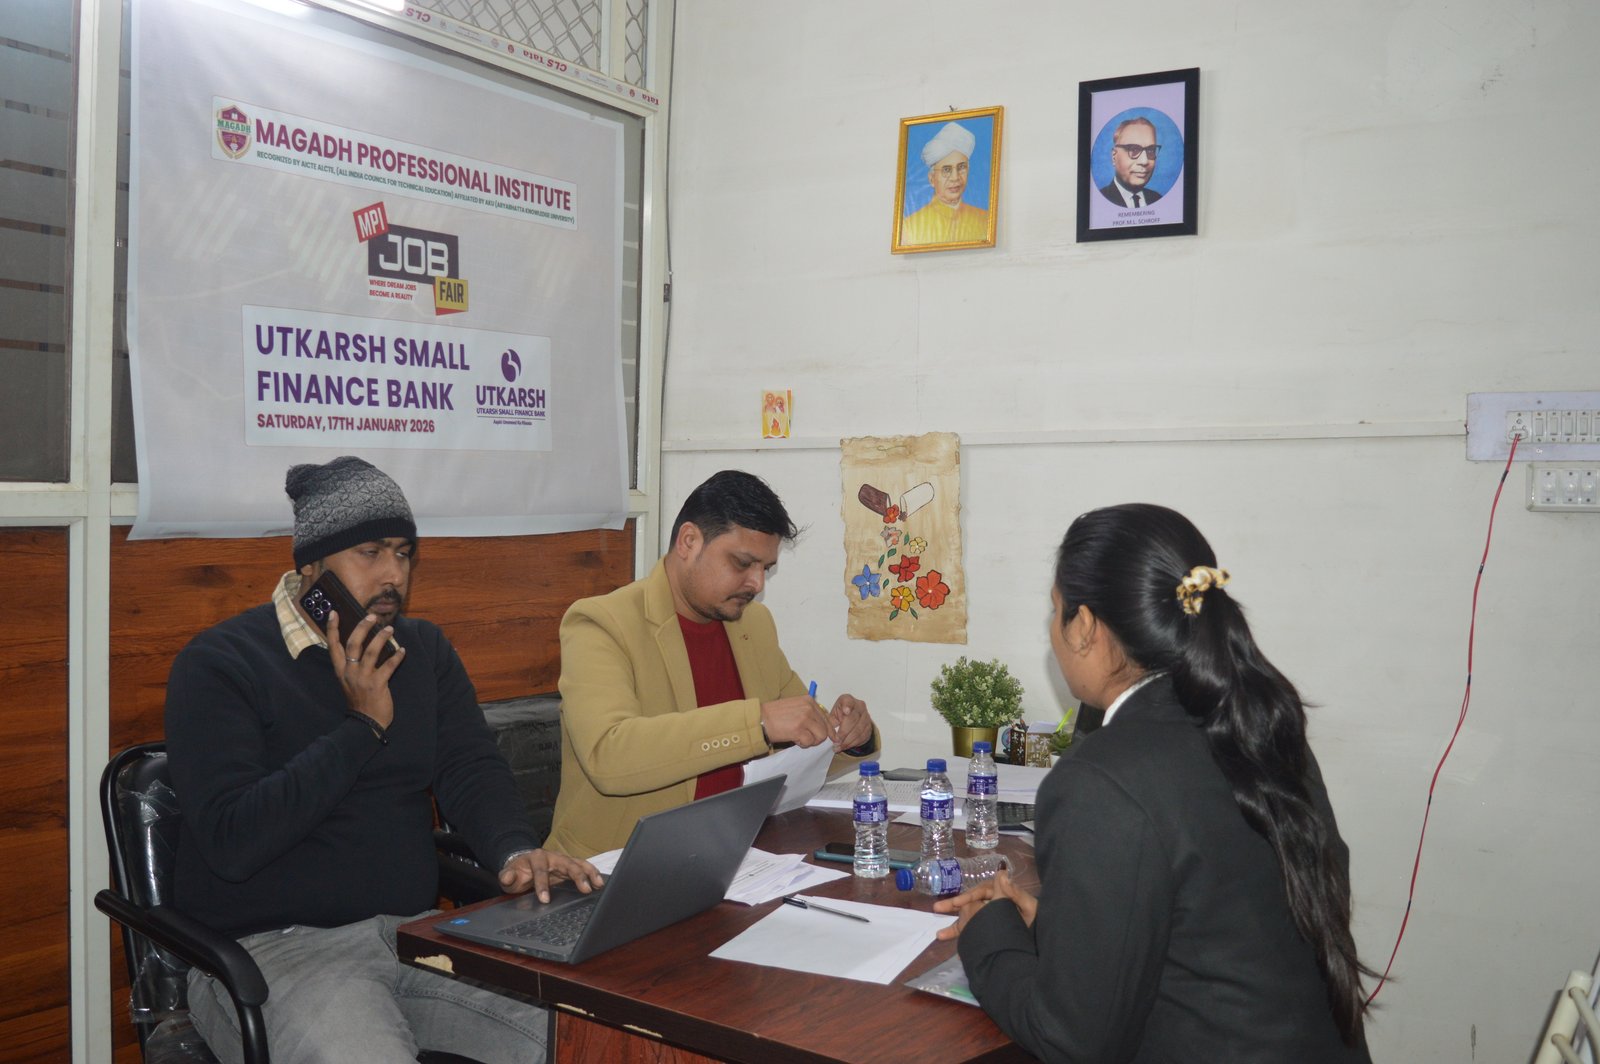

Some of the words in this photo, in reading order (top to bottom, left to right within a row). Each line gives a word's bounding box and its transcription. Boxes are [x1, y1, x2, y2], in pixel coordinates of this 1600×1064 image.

[406, 7, 431, 22] CLS
[523, 49, 544, 64] Tata
[546, 58, 567, 72] CLS
[217, 119, 251, 134] MAGADH
[256, 119, 352, 163] MAGADH
[357, 142, 491, 194] PROFESSIONAL
[494, 174, 571, 211] INSTITUTE
[257, 150, 292, 165] RECOGNIZED
[292, 158, 301, 167] BY
[301, 160, 317, 170] AICTE
[348, 171, 364, 180] INDIA
[364, 173, 387, 185] COUNCIL
[387, 177, 397, 186] FOR
[397, 180, 424, 193] TECHNICAL
[454, 193, 478, 204] AFFILIATED
[1118, 210, 1155, 218] REMEMBERING
[1138, 217, 1161, 225] SCHROFF
[357, 207, 385, 239] MPI
[379, 233, 449, 278] JOB
[369, 279, 387, 287] WHERE
[387, 281, 404, 289] DREAM
[404, 283, 417, 291] JOBS
[439, 280, 465, 304] FAIR
[369, 289, 390, 298] BECOME
[395, 292, 413, 301] REALITY
[255, 324, 386, 364] UTKARSH
[394, 337, 470, 371] SMALL
[257, 370, 380, 407] FINANCE
[387, 379, 454, 411] BANK
[476, 384, 546, 409] UTKARSH
[476, 407, 498, 415] UTKARSH
[498, 408, 514, 416] SMALL
[514, 409, 534, 417] FINANCE
[257, 413, 326, 432] SATURDAY,
[327, 416, 355, 431] 17TH
[356, 417, 408, 432] JANUARY
[409, 418, 435, 433] 2026
